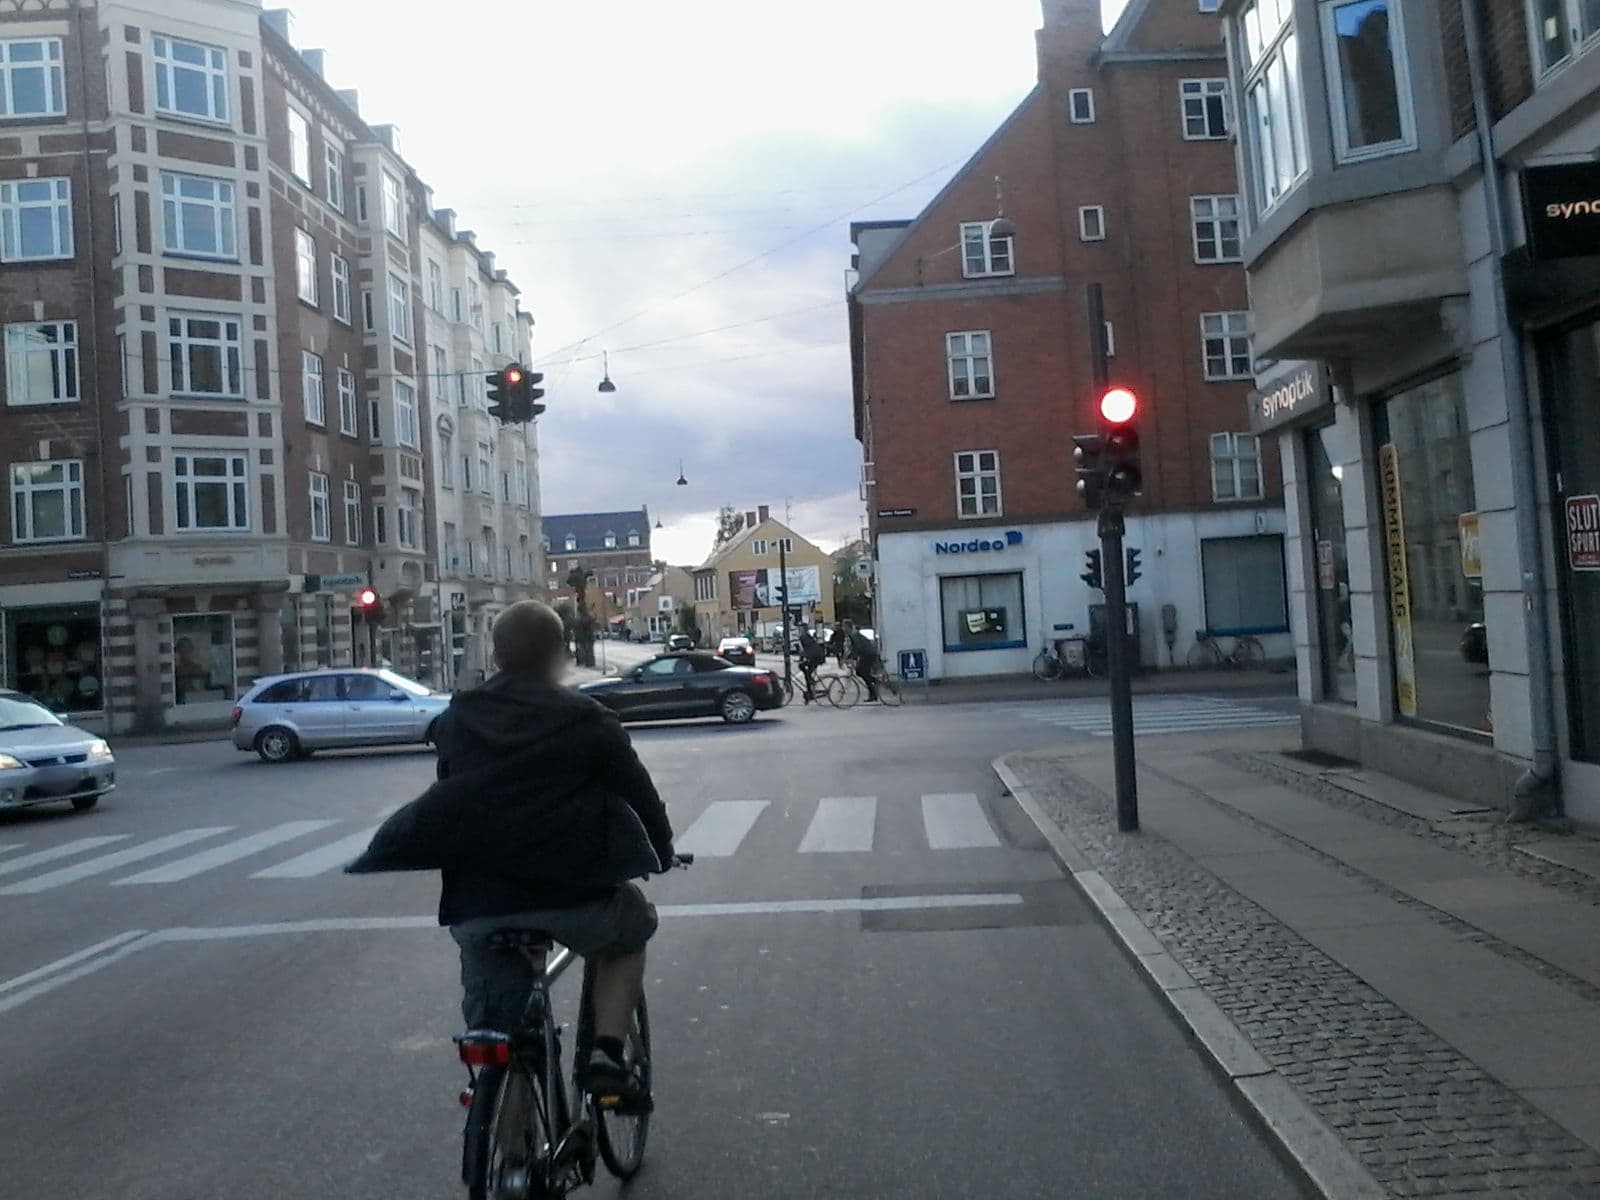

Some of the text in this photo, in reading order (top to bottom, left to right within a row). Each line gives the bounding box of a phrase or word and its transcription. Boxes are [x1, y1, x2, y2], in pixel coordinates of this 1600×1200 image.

[1263, 369, 1313, 419] synoptik
[1383, 453, 1407, 617] SOMMERSALG
[1569, 504, 1597, 531] SLUT
[1571, 531, 1599, 552] SPURT
